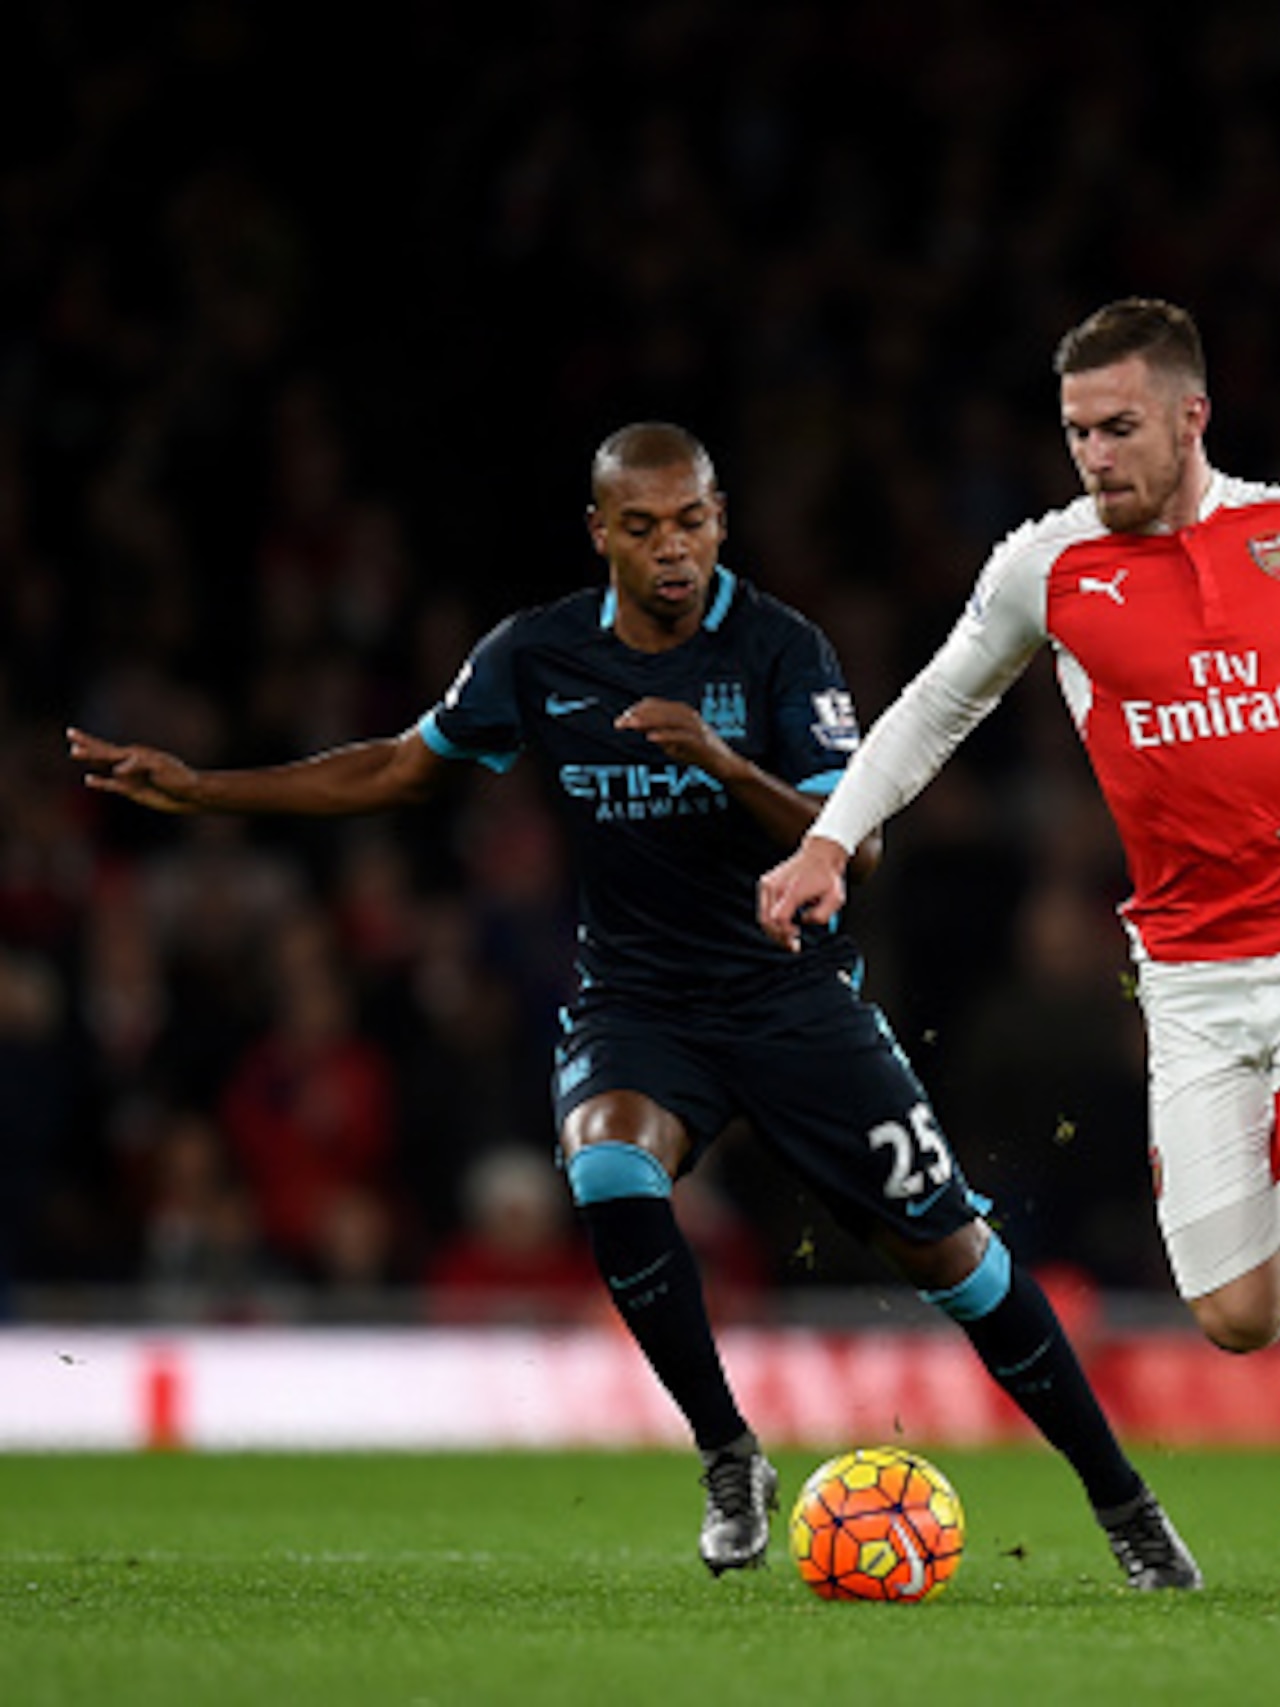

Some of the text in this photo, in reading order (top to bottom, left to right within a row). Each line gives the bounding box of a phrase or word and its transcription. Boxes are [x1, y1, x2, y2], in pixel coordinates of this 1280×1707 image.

[1188, 650, 1258, 687] Fly
[559, 763, 725, 800] ETIHA
[868, 1102, 952, 1198] 25
